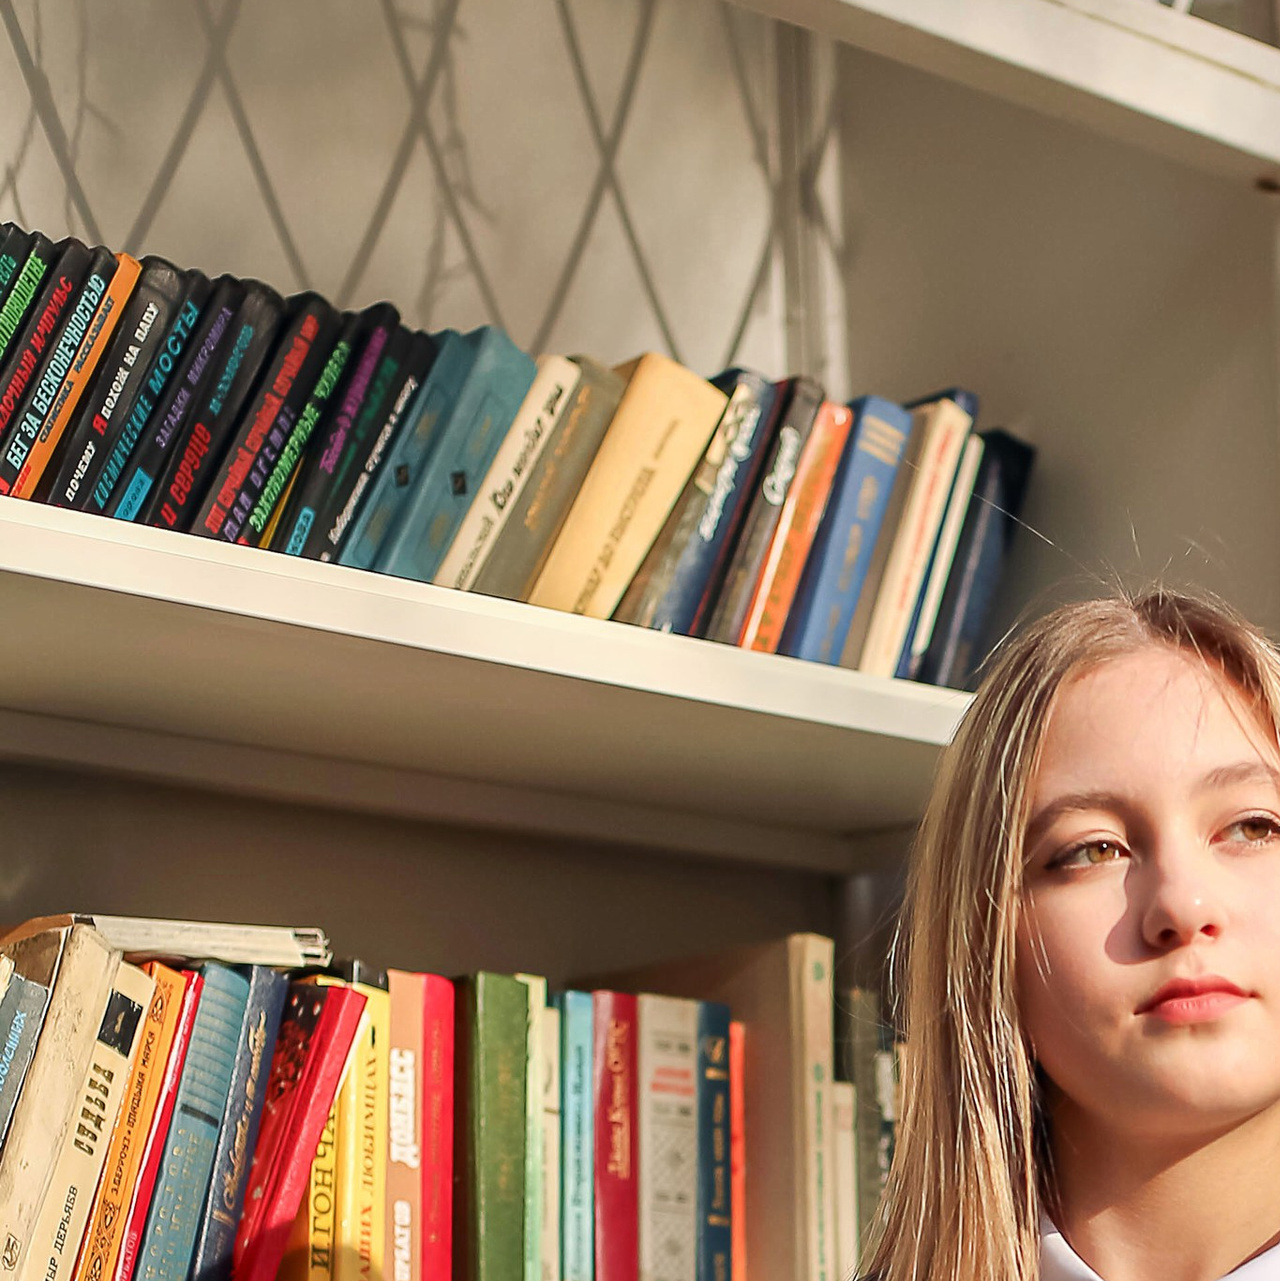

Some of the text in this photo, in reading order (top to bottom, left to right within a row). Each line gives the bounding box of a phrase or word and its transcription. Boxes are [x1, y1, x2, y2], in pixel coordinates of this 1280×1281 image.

[5, 432, 30, 470] БЕГ
[19, 409, 42, 438] ЗА
[32, 273, 107, 415] БЕСКОНЕЧНОСТЬЮ
[31, 275, 73, 352] ИМПУЛЬС
[38, 295, 114, 443] СТАТИСТИКА РАССКАЗЫВАЕТ
[155, 307, 233, 448] ЗАГАДКИ МИКРОМИРА
[64, 301, 159, 501] ПОЧЕМУ Я ПОХОЖ НА ПАПУ
[91, 299, 200, 508] КОСМИЧЕСКИЕ МОСТЫ
[166, 420, 214, 505] сердце
[249, 401, 320, 532] ЗАКОНОМЕРНЫЕ
[72, 1062, 115, 1157] СУДЬБА
[126, 1071, 147, 1128] ВЛАДЫКА
[141, 1031, 155, 1068] МАРСА
[364, 1055, 377, 1194] ЛЮБИМЦАХ
